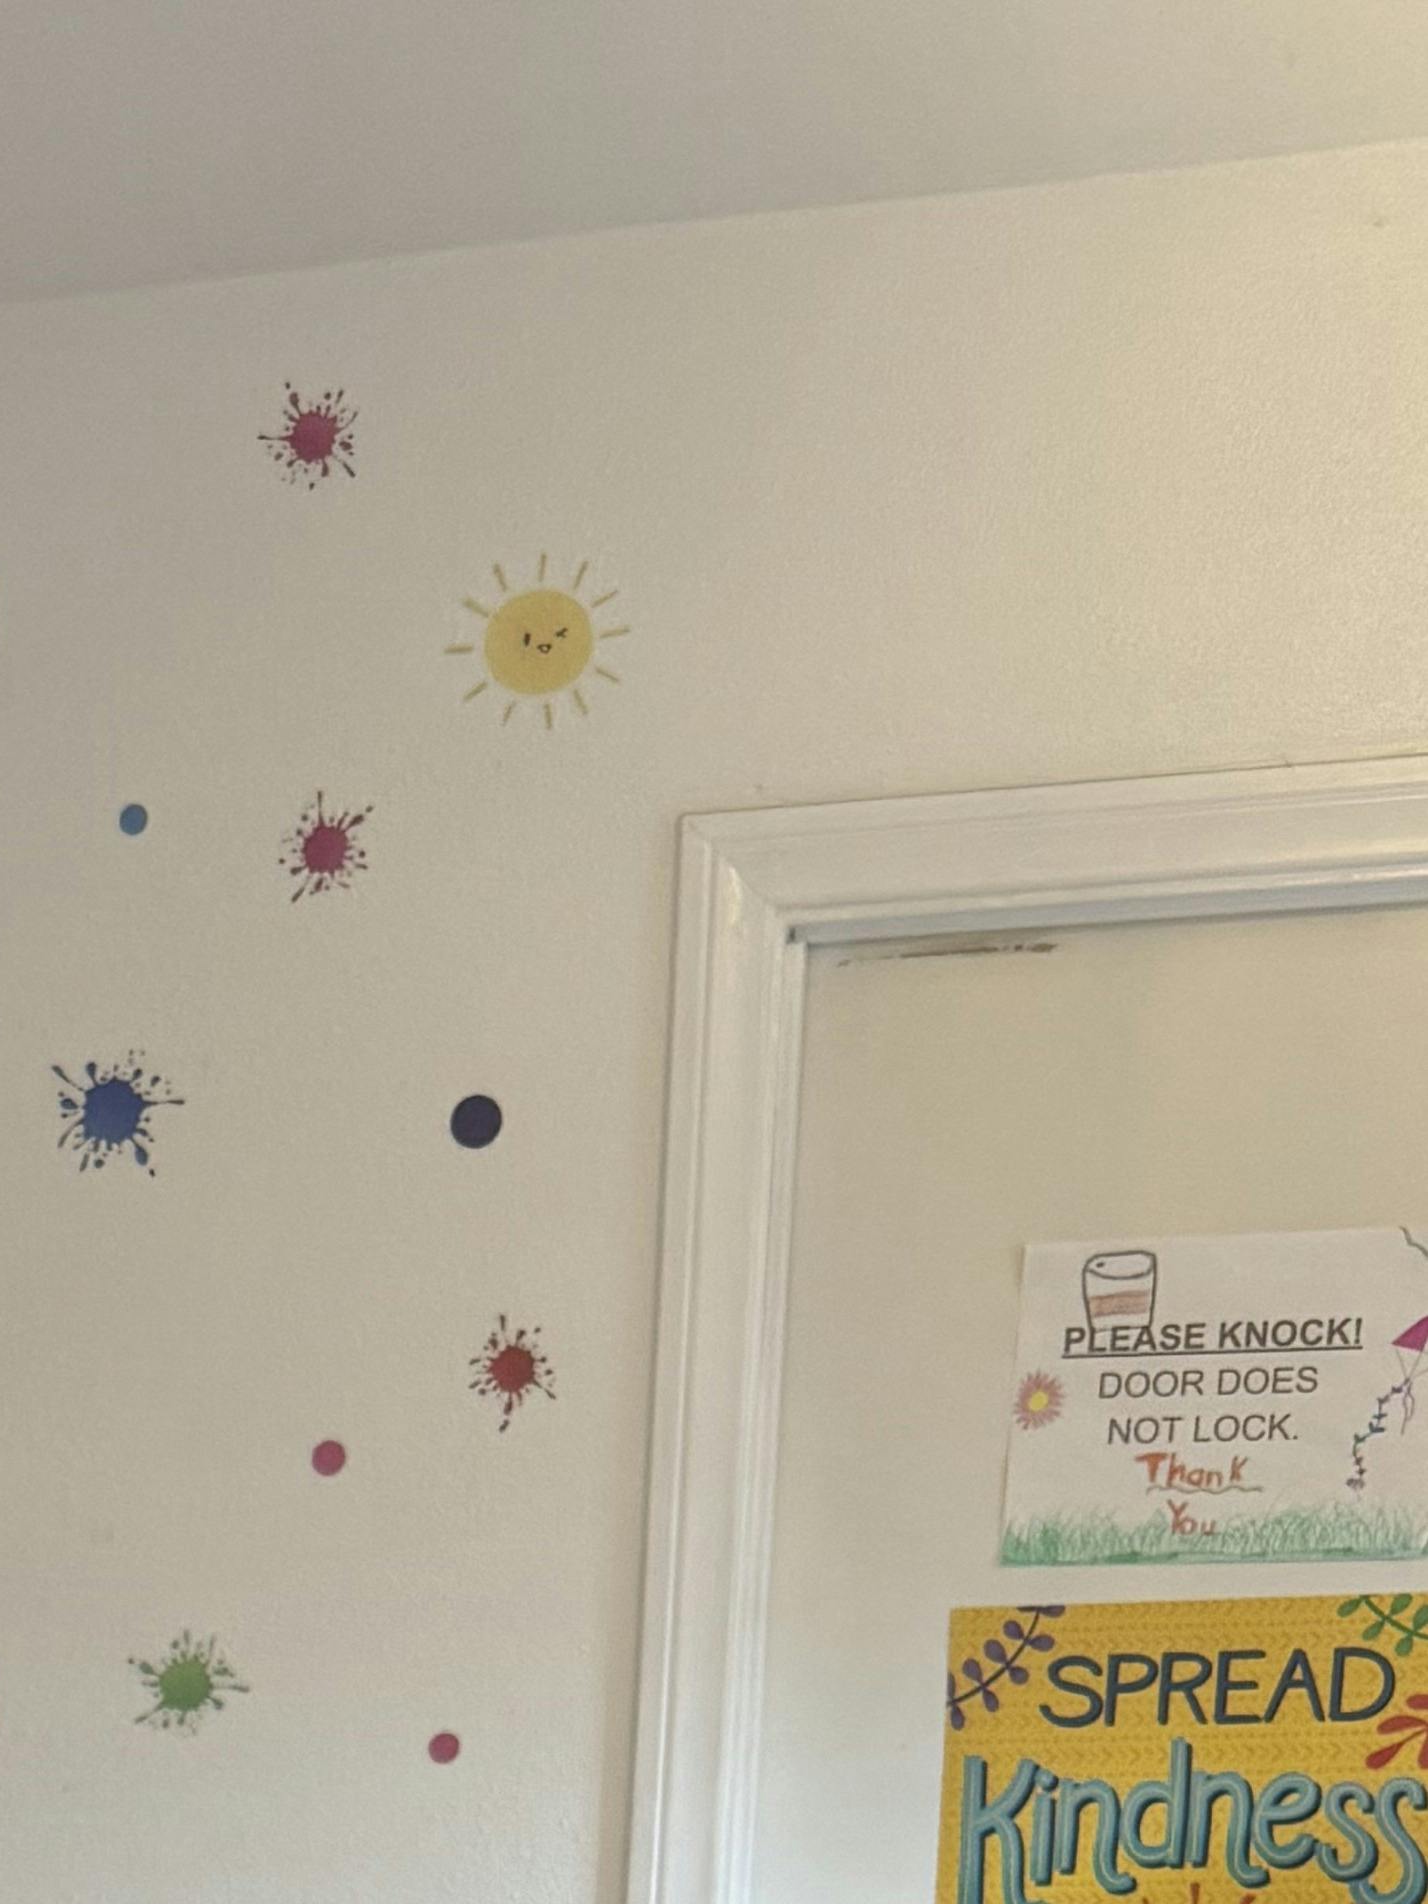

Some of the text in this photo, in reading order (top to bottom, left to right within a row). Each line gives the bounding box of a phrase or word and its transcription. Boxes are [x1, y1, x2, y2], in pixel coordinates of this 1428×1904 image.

[1062, 1317, 1364, 1356] PLEASE KNOCK!
[1098, 1366, 1320, 1400] DOOR DOES
[1106, 1413, 1300, 1445] NOT LOCK.
[1133, 1451, 1250, 1488] Thank
[1165, 1499, 1217, 1537] You
[1039, 1646, 1397, 1728] SPREAD
